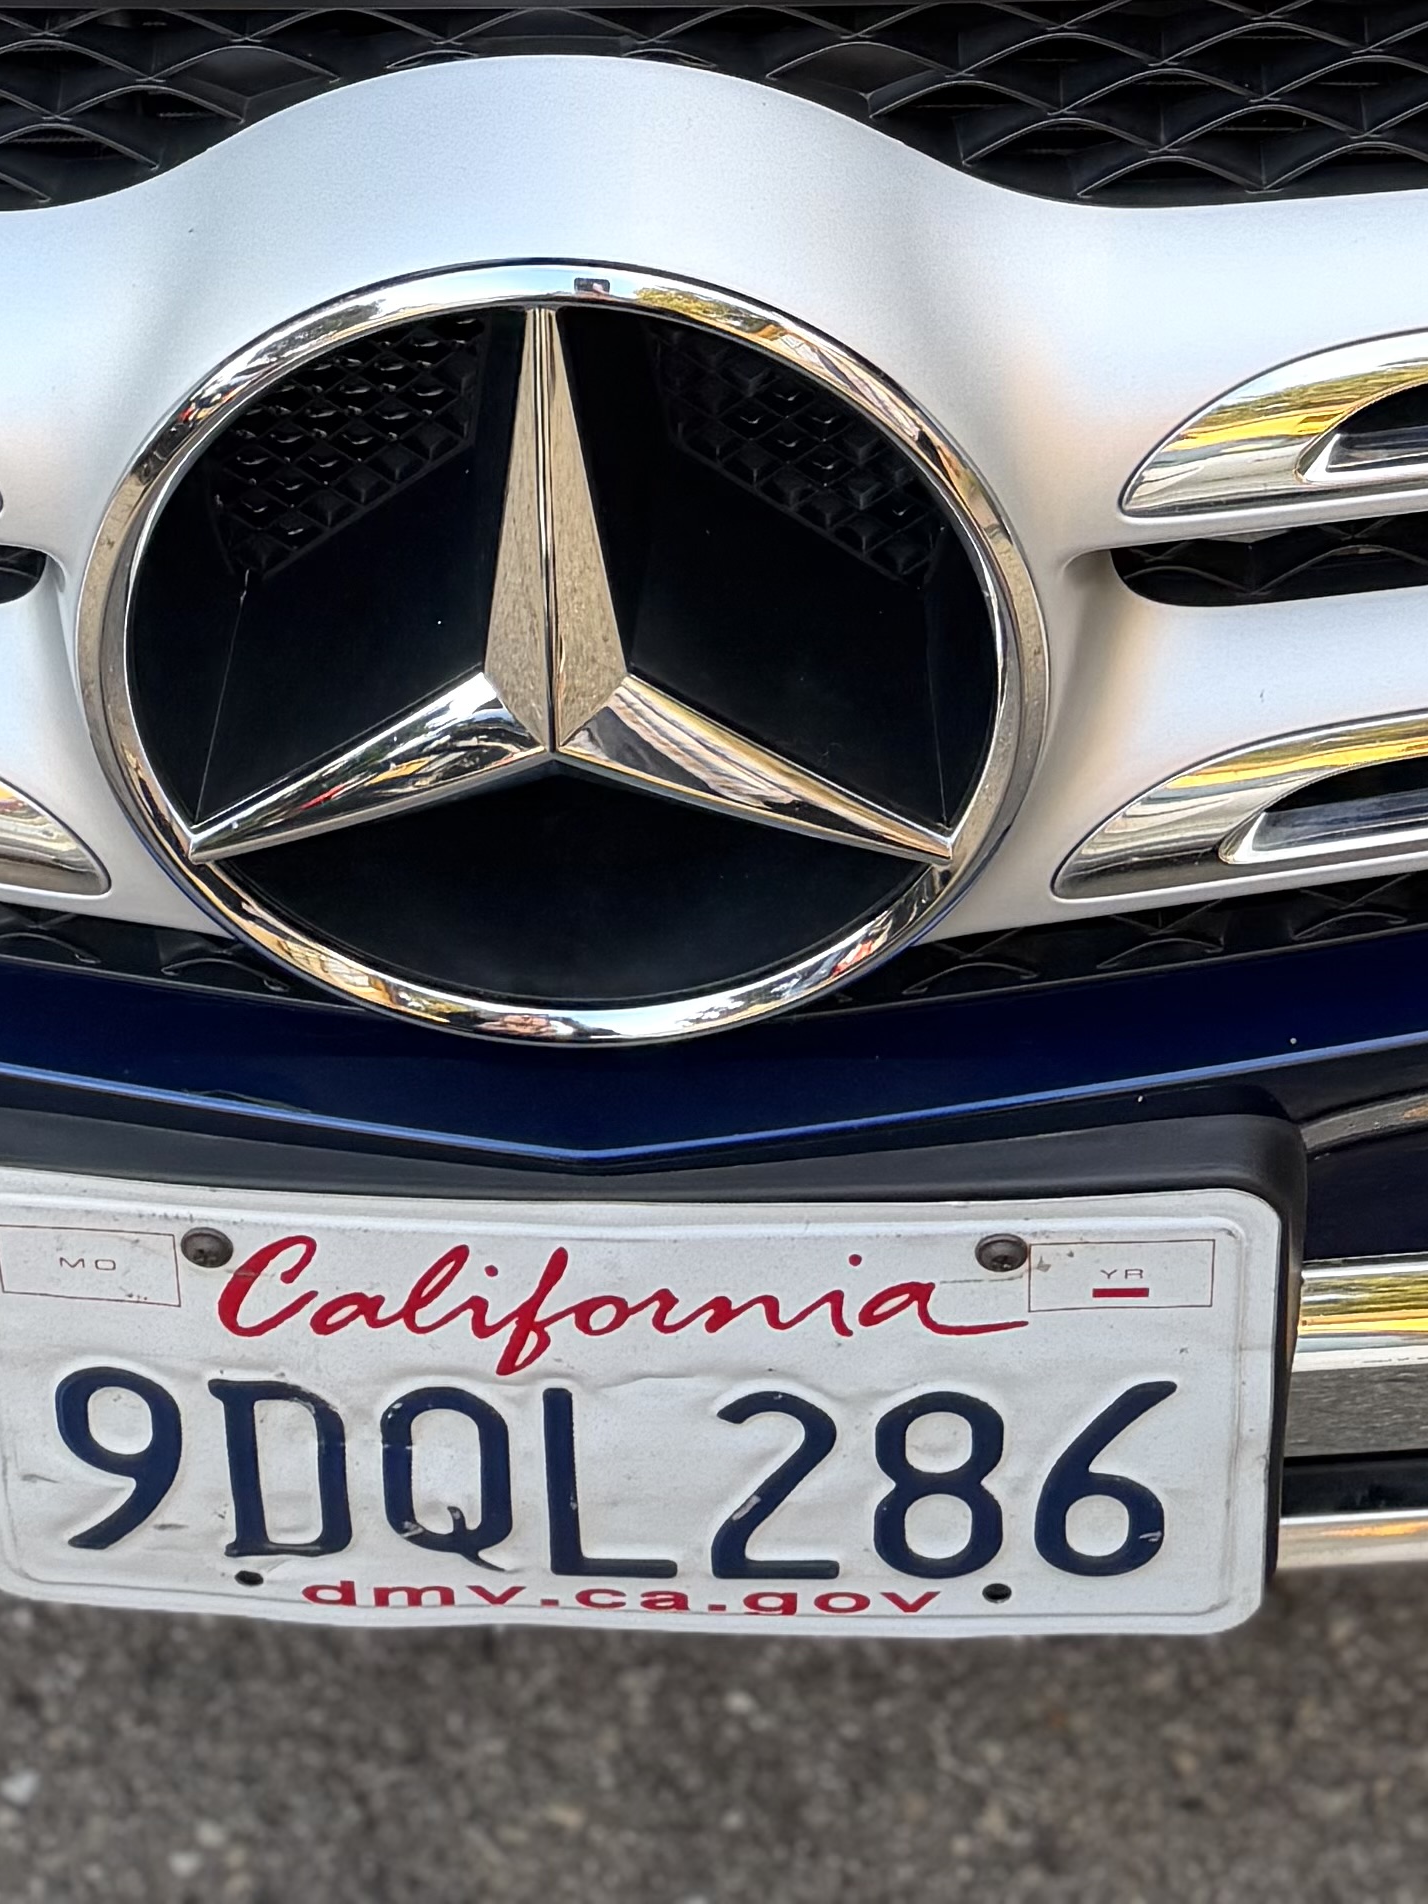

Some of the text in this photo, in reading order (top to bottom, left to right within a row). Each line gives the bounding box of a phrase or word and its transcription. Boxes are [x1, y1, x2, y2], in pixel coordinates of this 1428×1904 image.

[59, 1256, 117, 1271] MO
[1100, 1268, 1144, 1280] YR
[217, 1235, 1029, 1376] California
[54, 1364, 1179, 1581] 9DQL286
[301, 1580, 942, 1617] dmv.ca.gov
